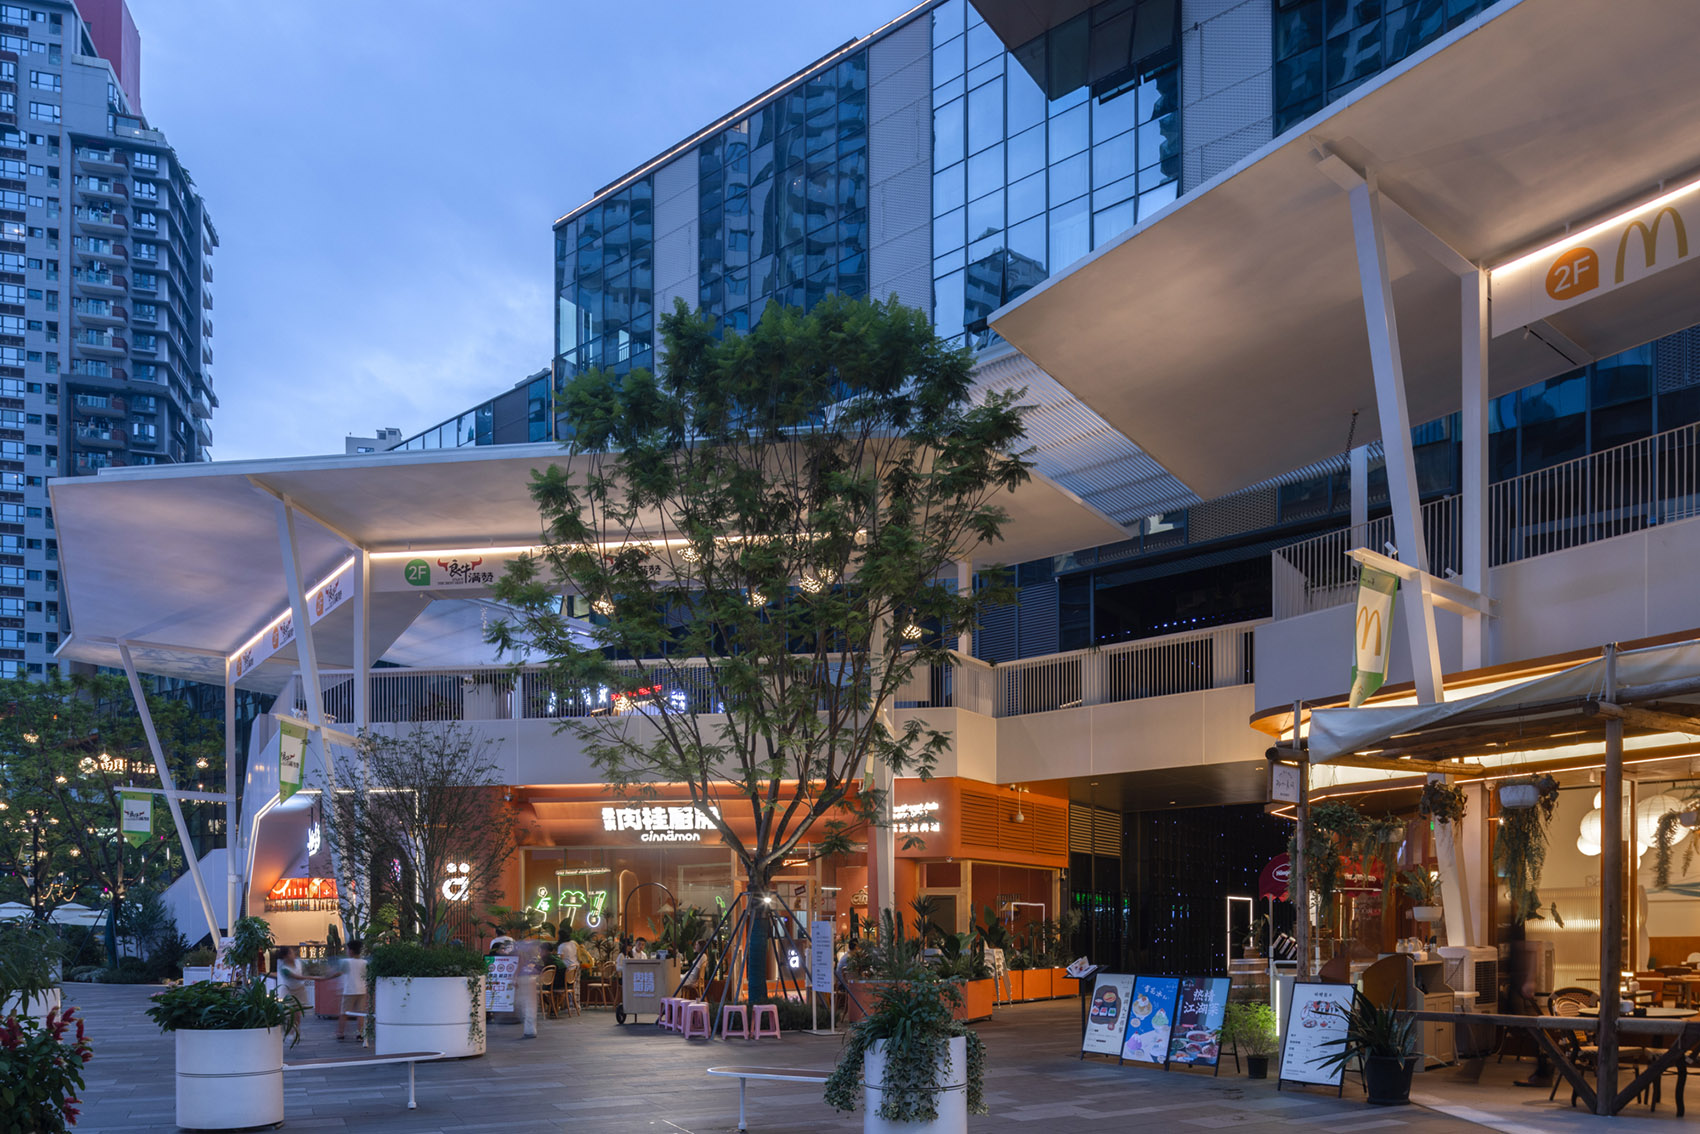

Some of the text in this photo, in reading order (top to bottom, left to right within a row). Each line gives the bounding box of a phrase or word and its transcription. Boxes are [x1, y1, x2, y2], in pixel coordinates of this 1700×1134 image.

[1553, 255, 1591, 294] 2F
[408, 565, 427, 580] 2F
[1193, 988, 1216, 1002] 热情
